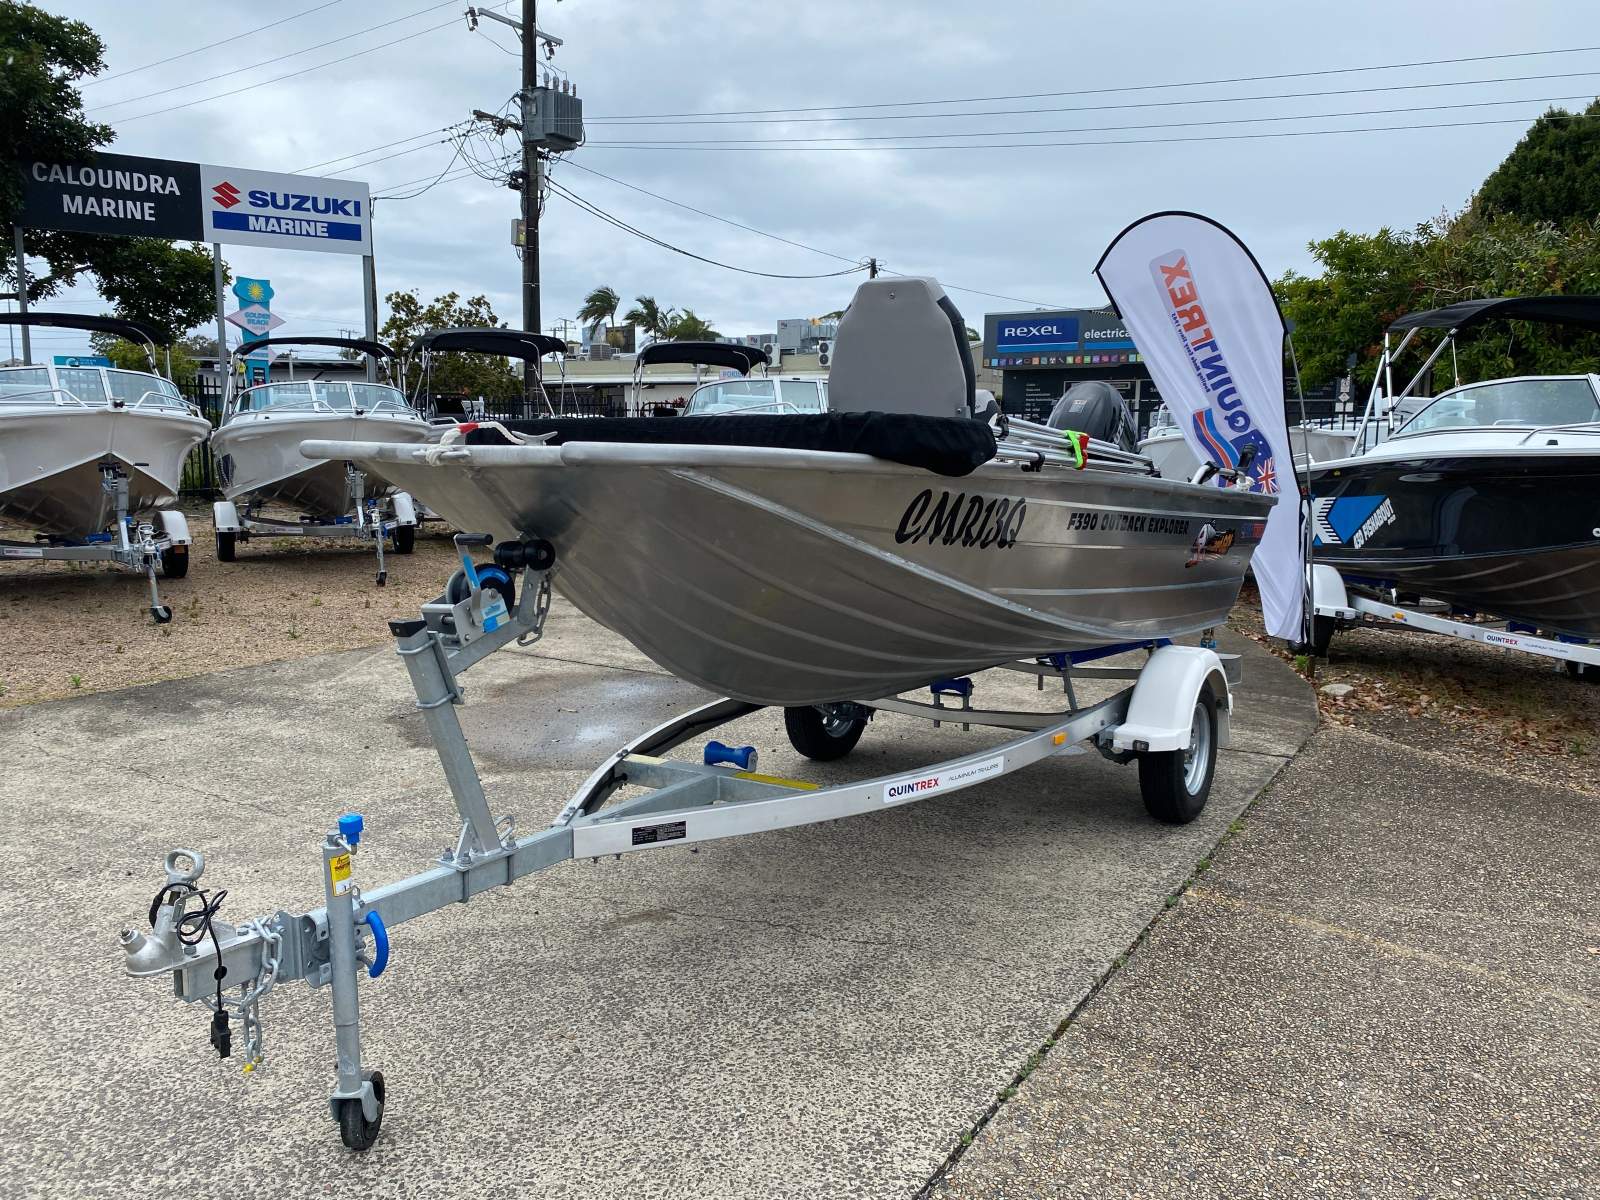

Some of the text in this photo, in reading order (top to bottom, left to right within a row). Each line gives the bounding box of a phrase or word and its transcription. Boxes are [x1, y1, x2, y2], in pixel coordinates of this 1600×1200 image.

[32, 161, 181, 196] CALOUNDRA
[62, 194, 156, 221] MARINE
[248, 190, 361, 217] SUZUKI
[248, 215, 329, 237] MARINE
[1084, 328, 1131, 339] electrica
[895, 488, 1026, 549] CMR13Q
[1067, 512, 1190, 535] F390 OUTBACK EXPLORER
[1486, 634, 1518, 646] QUINTREX
[888, 777, 940, 797] QUINTREX
